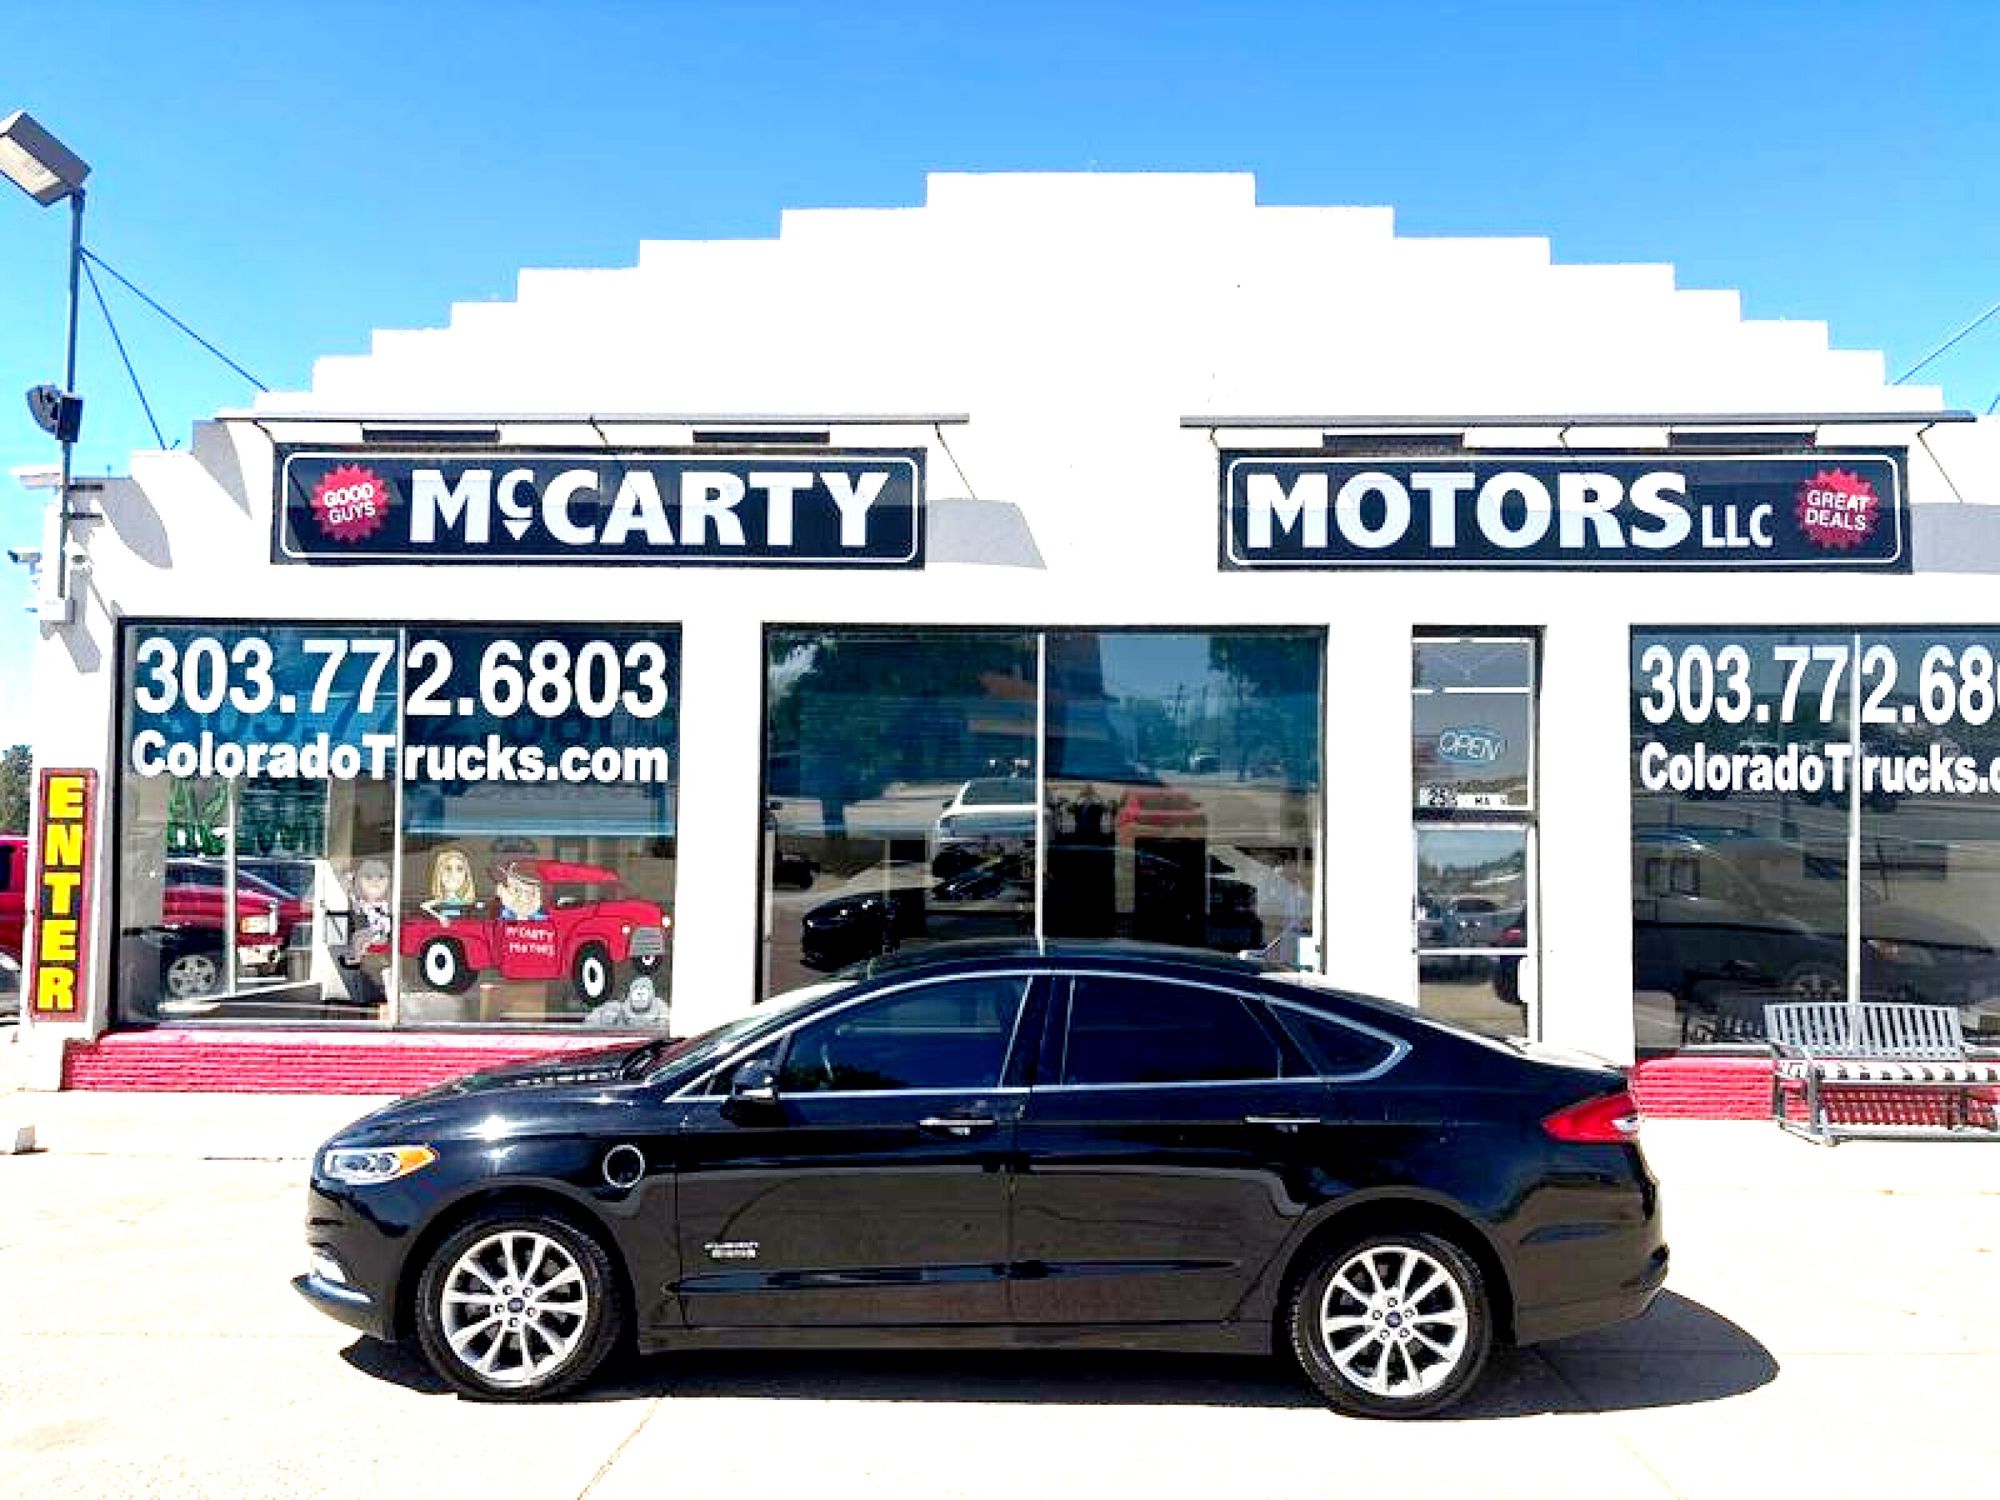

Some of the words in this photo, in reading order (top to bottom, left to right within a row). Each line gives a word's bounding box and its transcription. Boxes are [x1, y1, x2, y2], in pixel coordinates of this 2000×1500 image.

[324, 483, 374, 508] GOOD
[1807, 489, 1870, 512] GREAT
[330, 502, 376, 524] GUYS
[1246, 471, 1691, 549] MOTORS
[1702, 504, 1773, 548] LLC
[1805, 507, 1866, 531] DEALS
[1439, 731, 1501, 761] OPEN
[37, 776, 85, 1009] ENTER
